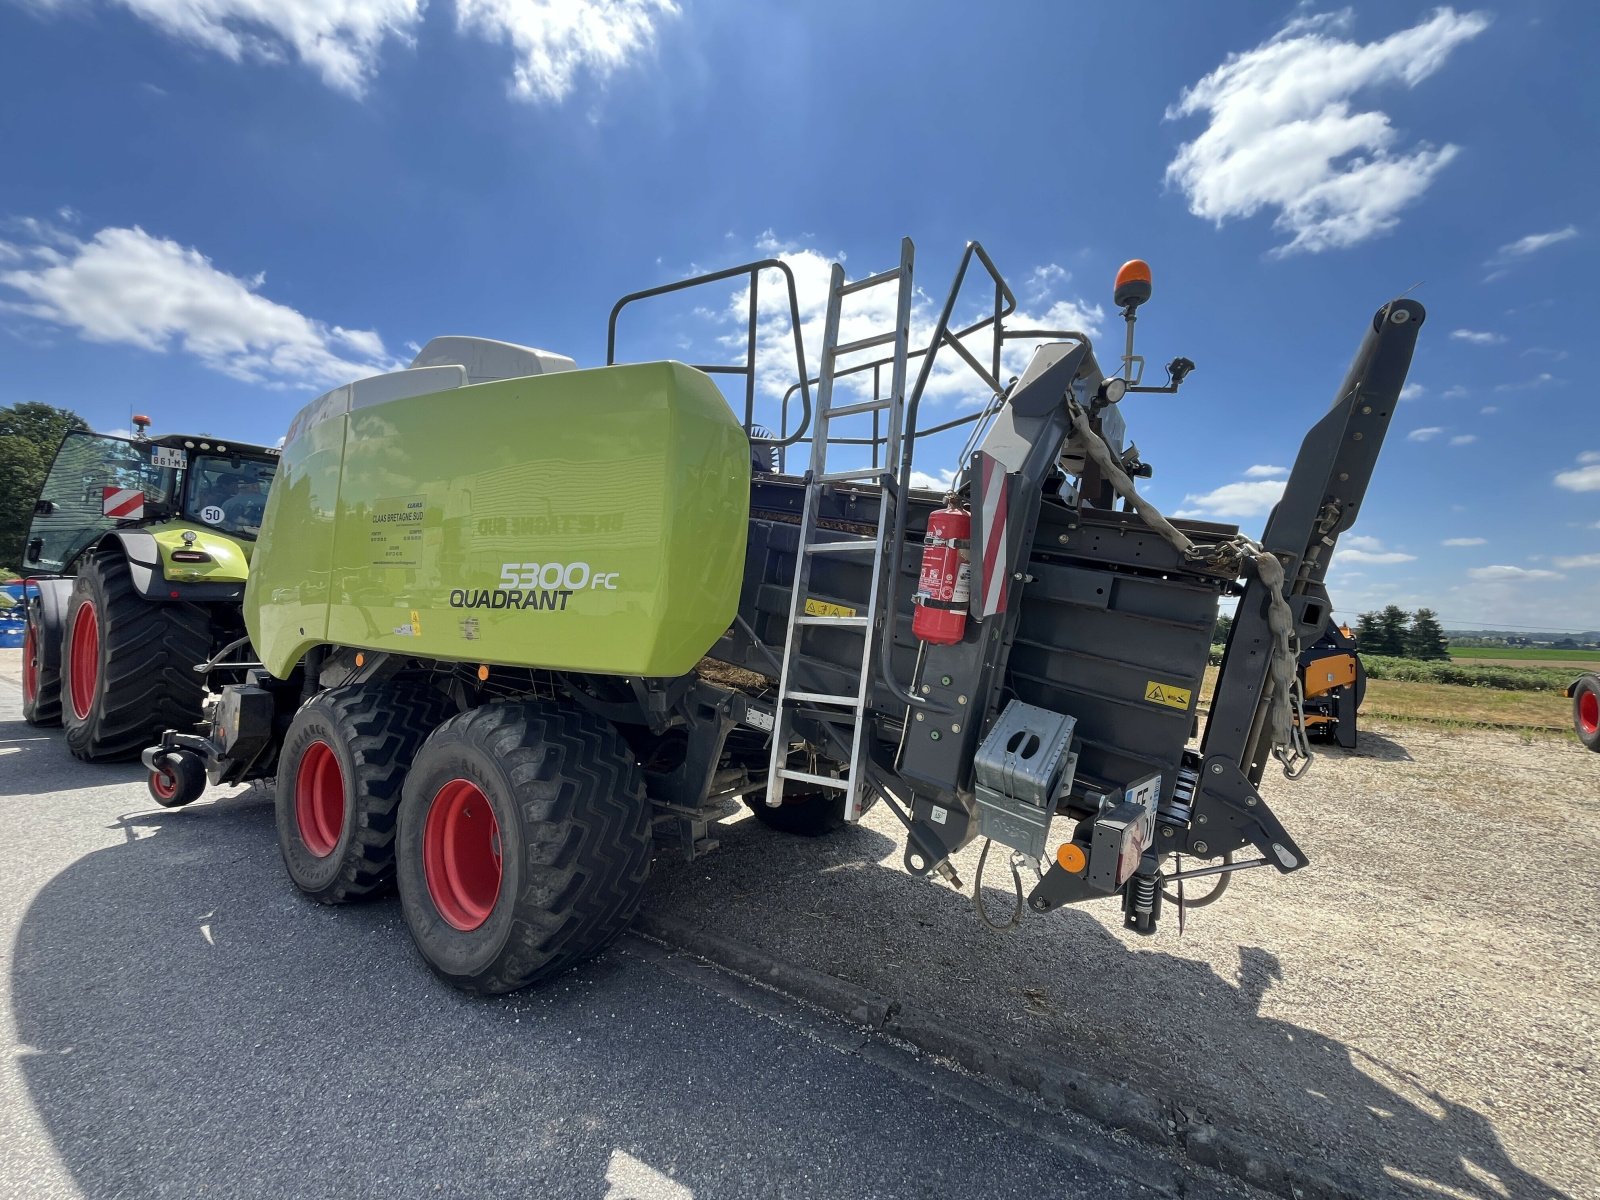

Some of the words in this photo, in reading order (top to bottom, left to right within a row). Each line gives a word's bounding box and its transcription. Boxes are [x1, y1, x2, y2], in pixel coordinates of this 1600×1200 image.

[153, 456, 187, 468] 861-MX
[205, 508, 220, 521] 50
[372, 513, 387, 523] CLAAS
[387, 511, 412, 522] BRETAGNE
[412, 511, 424, 521] SUD
[499, 562, 590, 590] 5300
[591, 572, 620, 590] FC
[450, 589, 574, 611] QUADRANT
